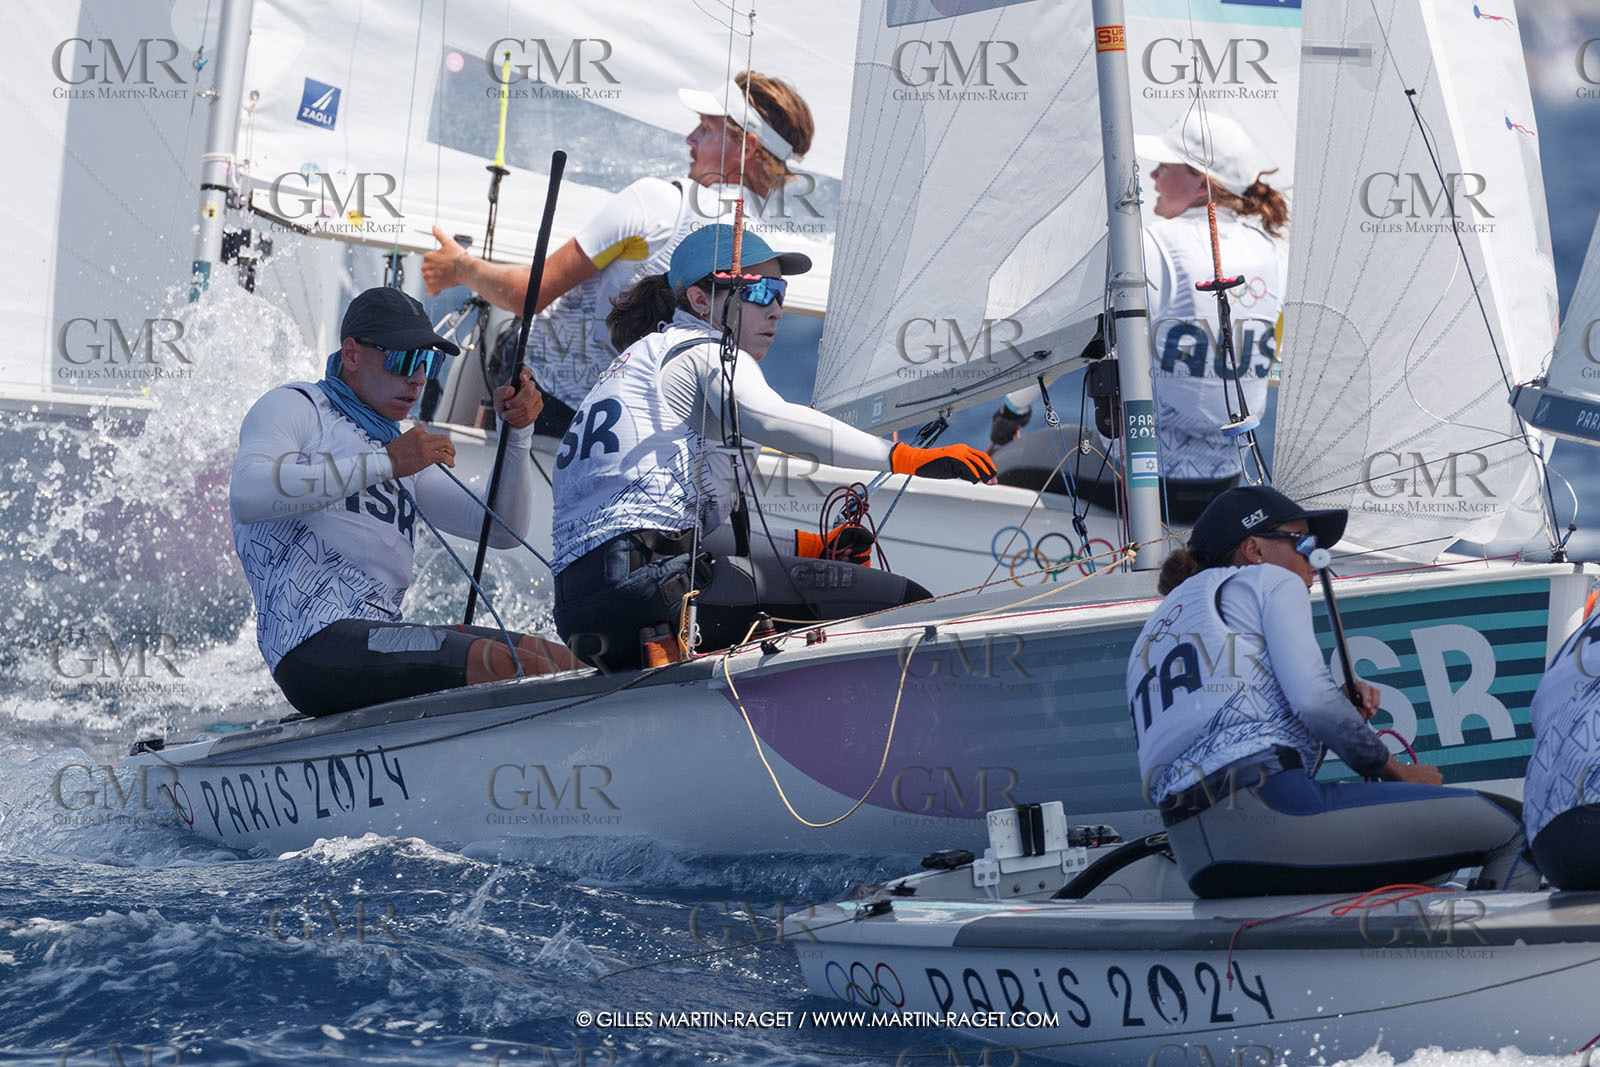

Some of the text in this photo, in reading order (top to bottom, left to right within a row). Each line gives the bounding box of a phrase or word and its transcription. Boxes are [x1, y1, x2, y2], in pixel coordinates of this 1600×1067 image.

[302, 107, 332, 125] ZAOLI
[1161, 324, 1276, 380] AUS
[557, 398, 622, 470] SR
[1129, 415, 1153, 426] PAR
[1130, 427, 1155, 439] 202
[1576, 410, 1600, 431] PAR
[1242, 509, 1264, 527] EA7
[1330, 624, 1516, 755] SR
[303, 745, 409, 819] 2024
[1107, 961, 1274, 1027] 2024
